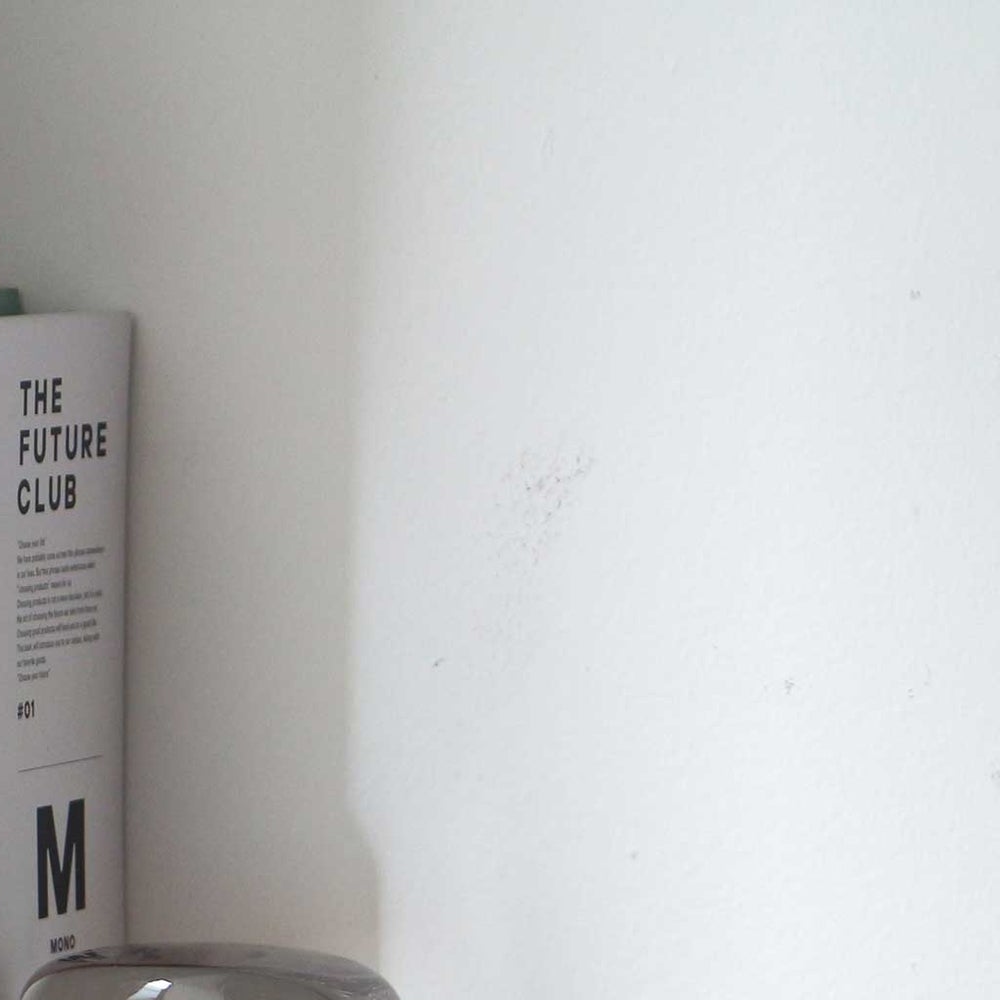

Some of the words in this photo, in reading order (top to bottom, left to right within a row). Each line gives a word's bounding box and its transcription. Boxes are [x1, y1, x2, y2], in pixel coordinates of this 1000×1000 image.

[19, 377, 63, 416] THE
[19, 421, 108, 466] FUTURE
[17, 474, 77, 516] CLUB
[17, 699, 36, 720] #01
[36, 798, 86, 920] M
[49, 934, 76, 954] MONO
